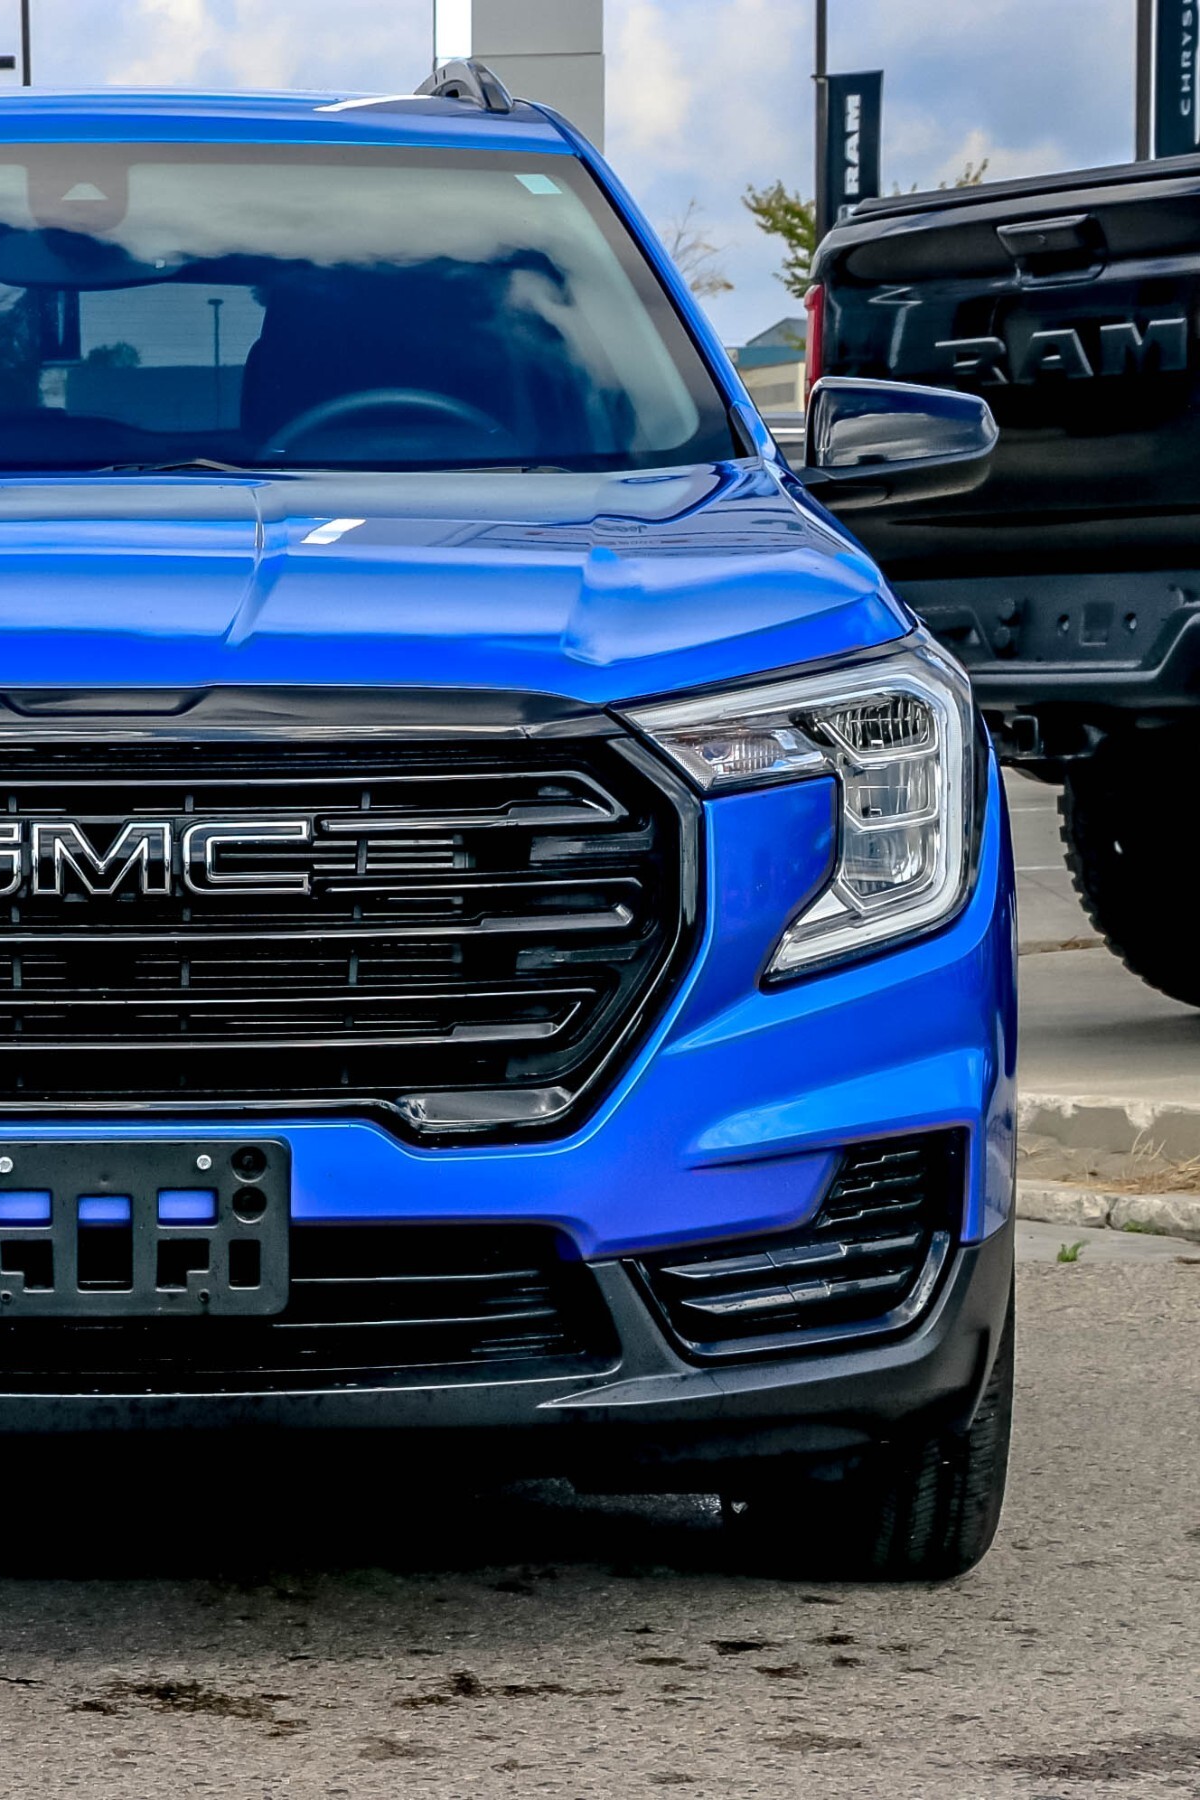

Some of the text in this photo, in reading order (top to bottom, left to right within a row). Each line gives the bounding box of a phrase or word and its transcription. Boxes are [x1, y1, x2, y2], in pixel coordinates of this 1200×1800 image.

[1180, 0, 1193, 116] CHRYS
[844, 94, 861, 195] RAM
[934, 317, 1188, 385] RAM
